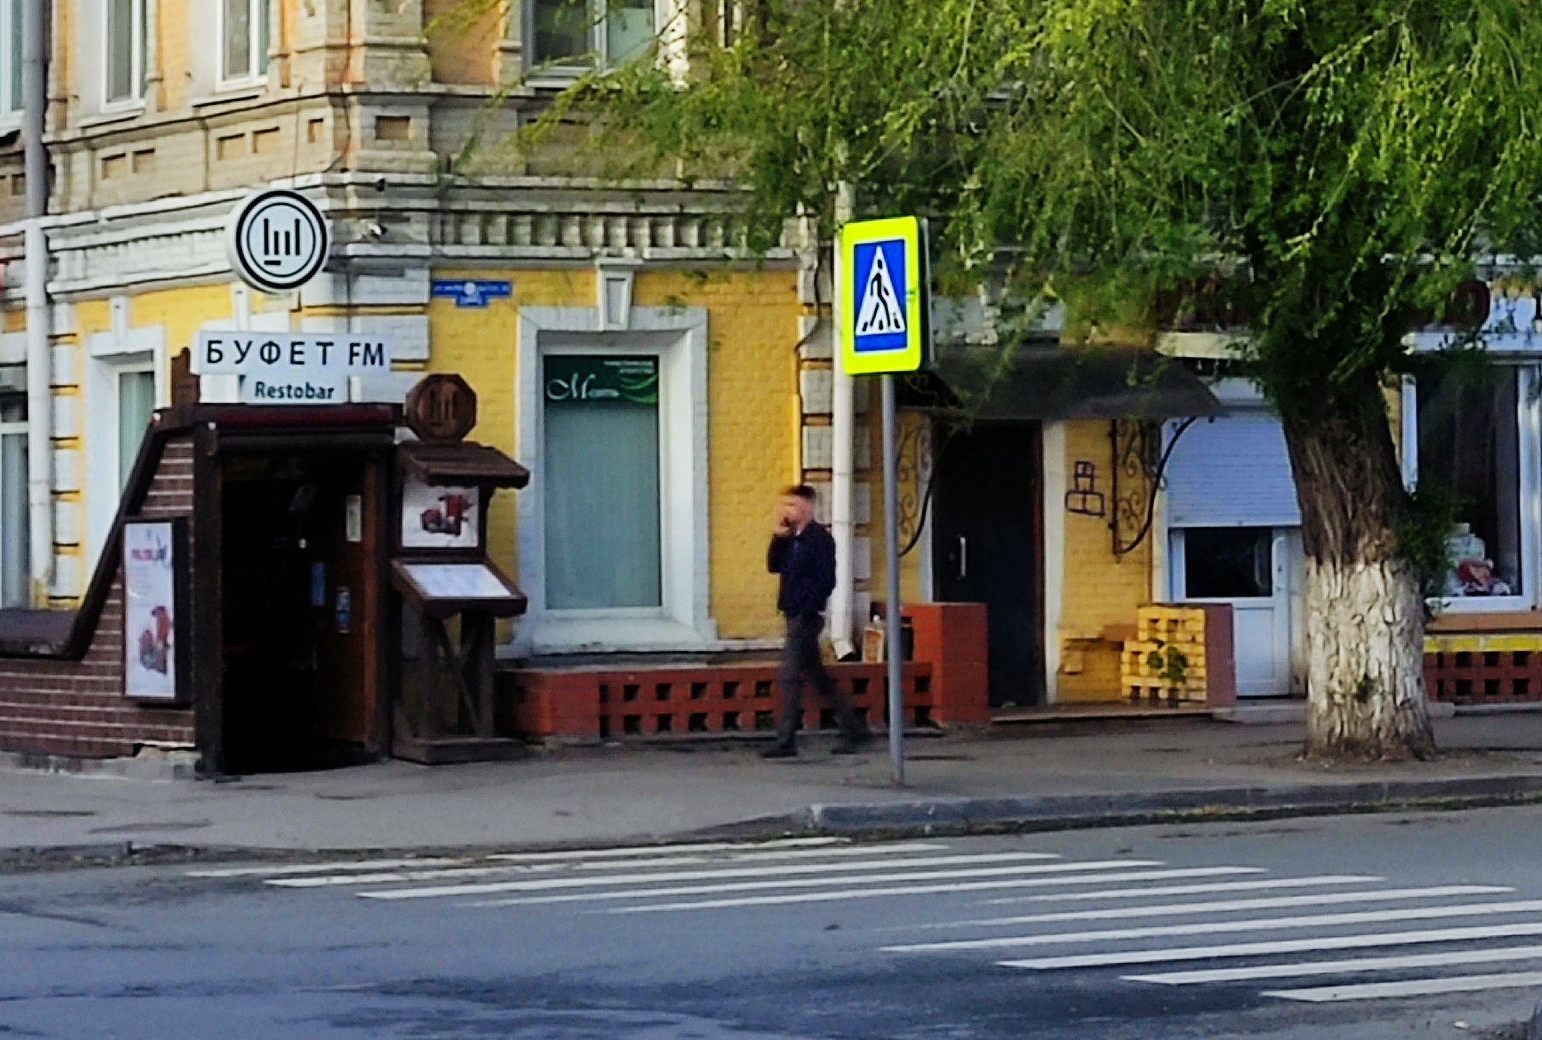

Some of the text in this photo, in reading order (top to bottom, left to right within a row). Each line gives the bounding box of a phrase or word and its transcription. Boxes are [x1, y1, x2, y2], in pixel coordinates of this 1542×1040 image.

[206, 339, 385, 367] БУФЕТ FM
[254, 381, 335, 400] Restobar
